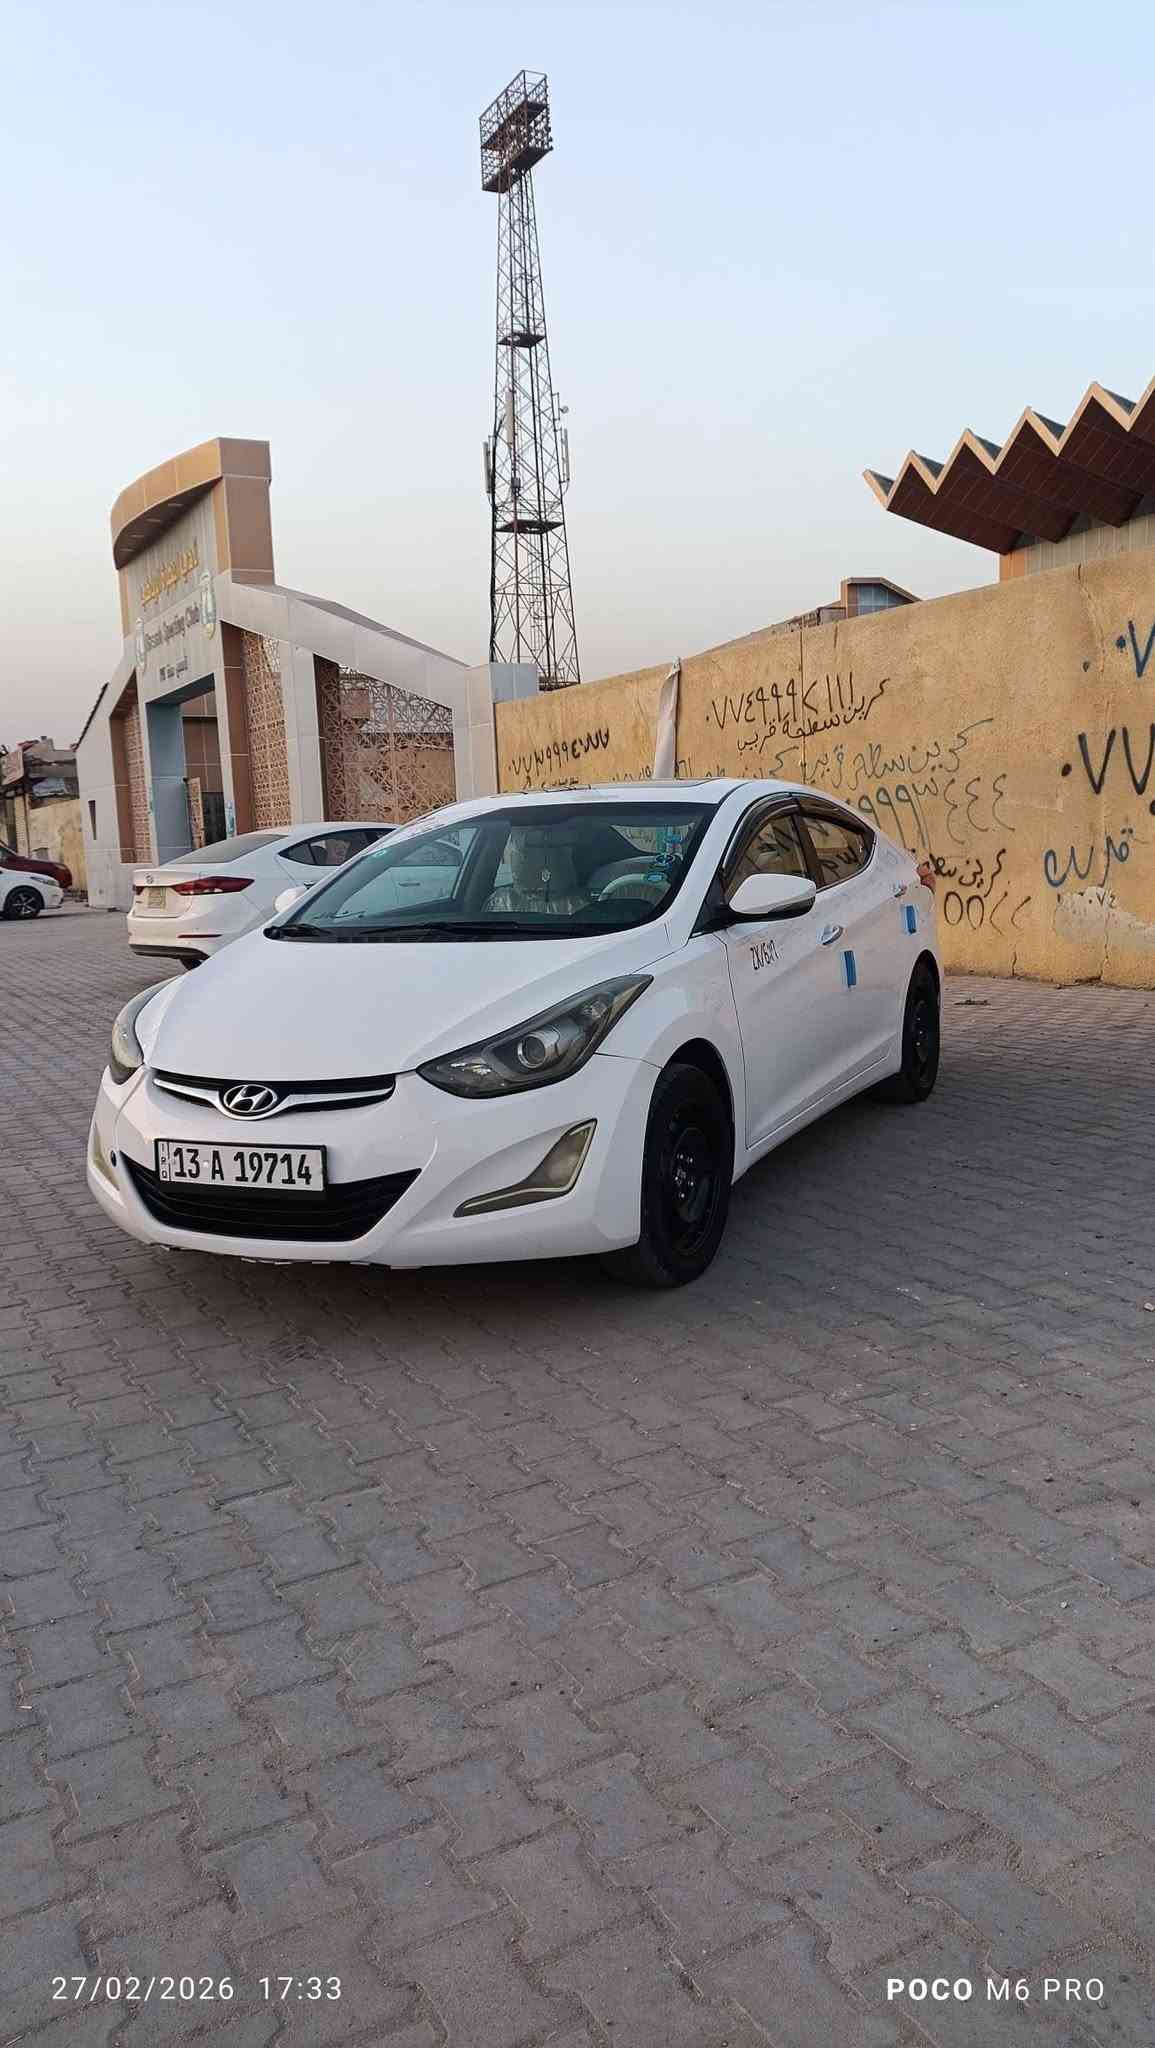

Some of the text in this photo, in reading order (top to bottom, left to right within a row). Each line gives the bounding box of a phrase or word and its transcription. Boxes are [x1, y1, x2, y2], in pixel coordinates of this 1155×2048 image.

[173, 1147, 312, 1185] 13 A 19714
